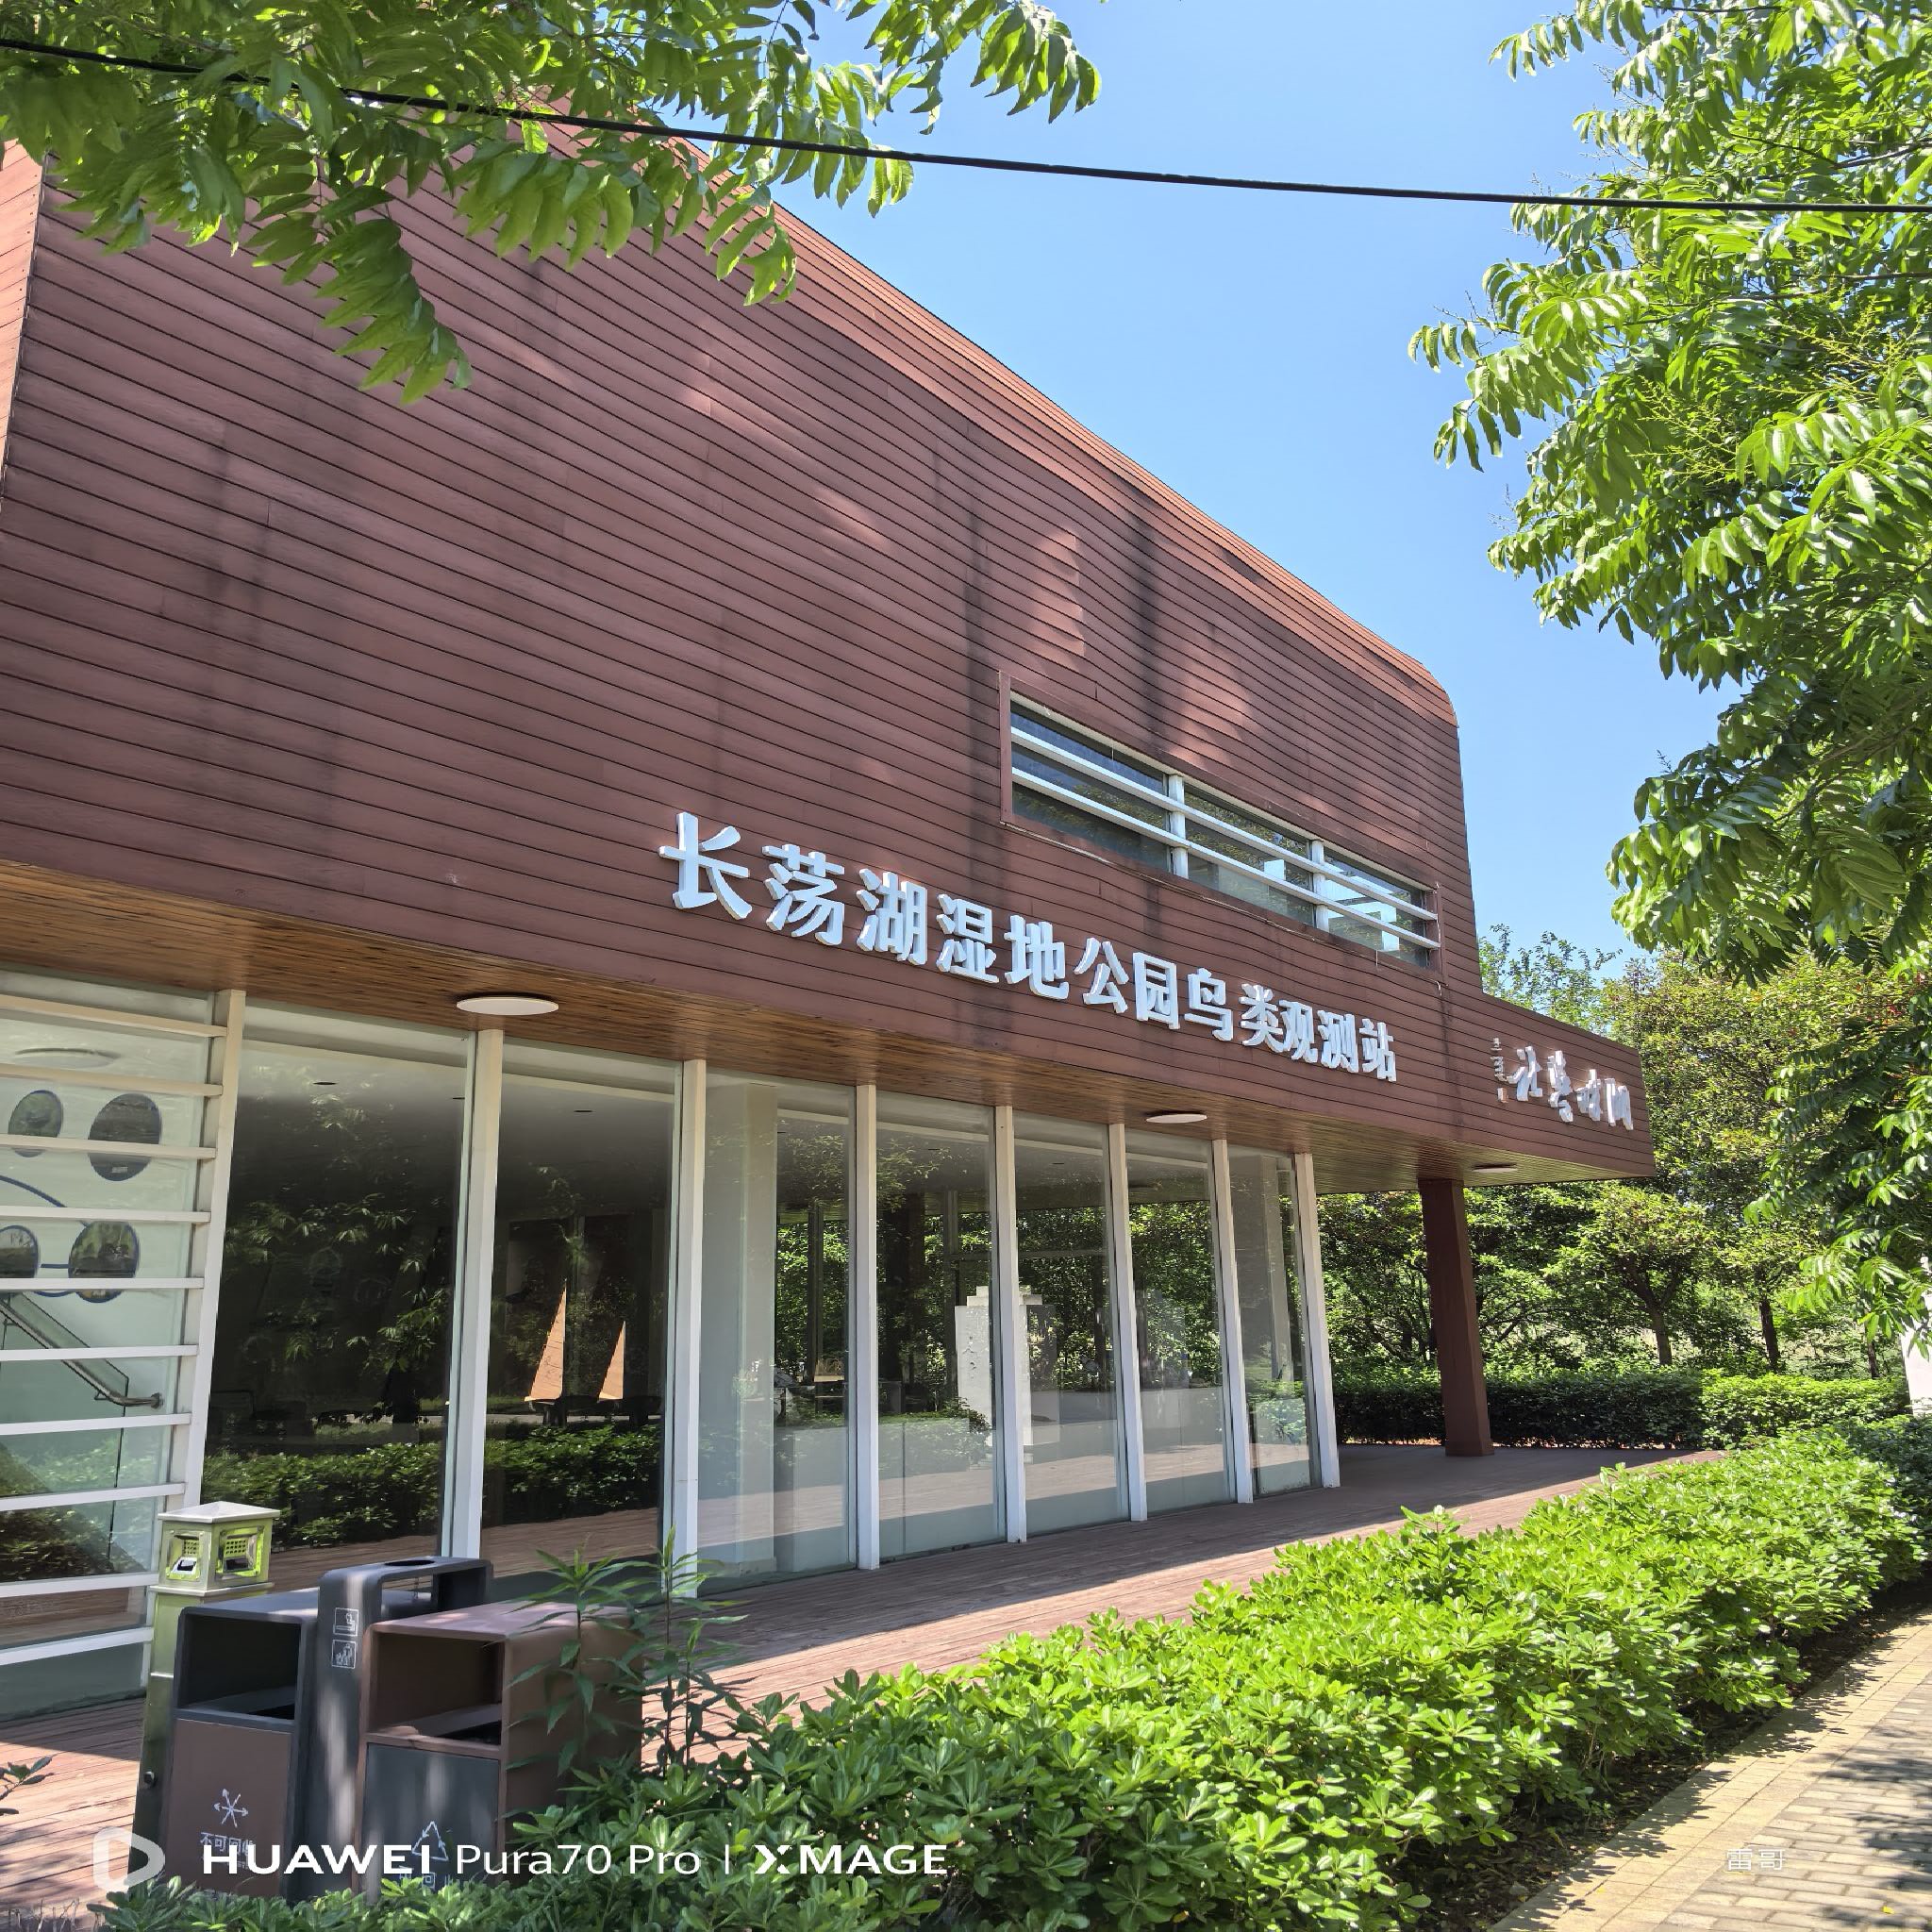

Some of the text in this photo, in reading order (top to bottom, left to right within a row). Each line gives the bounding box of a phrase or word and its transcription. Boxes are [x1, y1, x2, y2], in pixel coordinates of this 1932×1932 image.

[658, 811, 1397, 1082] 长荡湖湿地公园鸟类观测站
